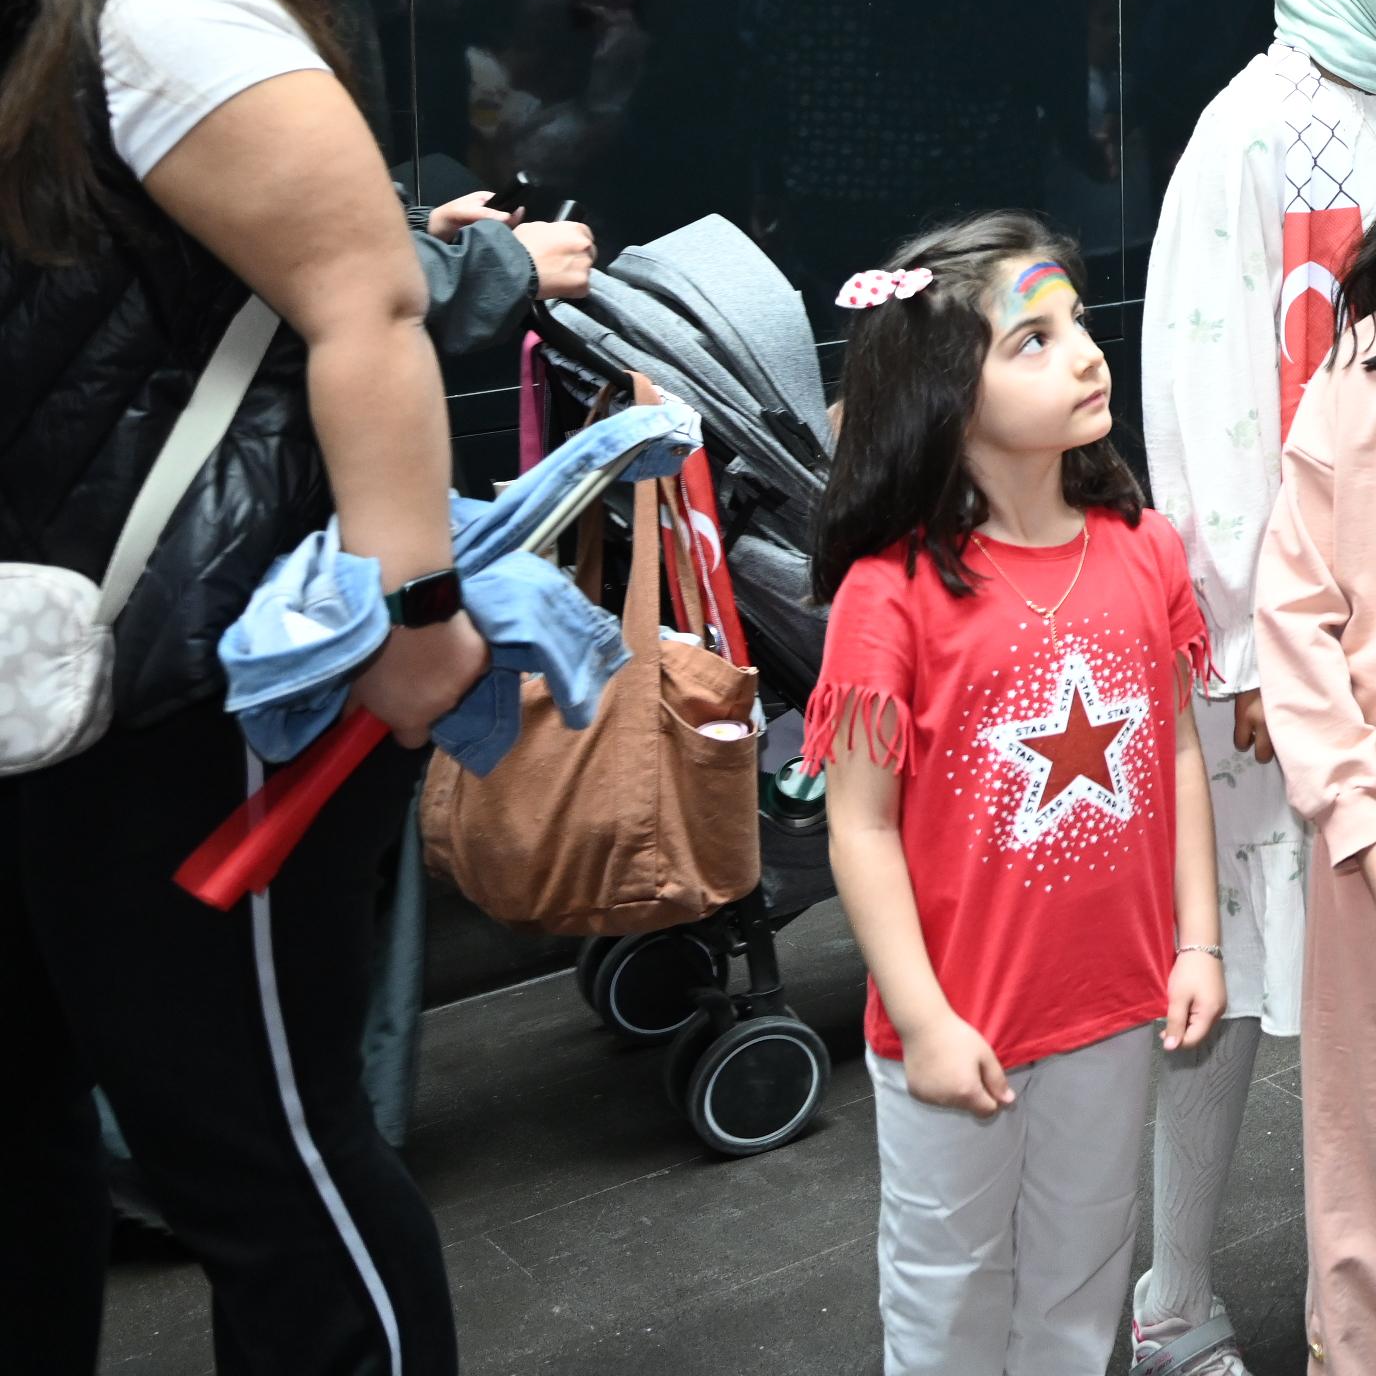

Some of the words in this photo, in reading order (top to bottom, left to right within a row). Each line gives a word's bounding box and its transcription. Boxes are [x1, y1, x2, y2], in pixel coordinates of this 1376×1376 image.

[1060, 678, 1072, 712] STAR
[1079, 676, 1095, 707] STAR
[1107, 706, 1131, 720] STAR
[1015, 724, 1047, 737] STAR
[1117, 718, 1136, 746] STAR
[1007, 742, 1035, 763] STAR
[1112, 763, 1124, 795] STAR
[1025, 780, 1042, 814] STAR
[1097, 790, 1118, 810] STAR
[1035, 799, 1063, 826] STAR
